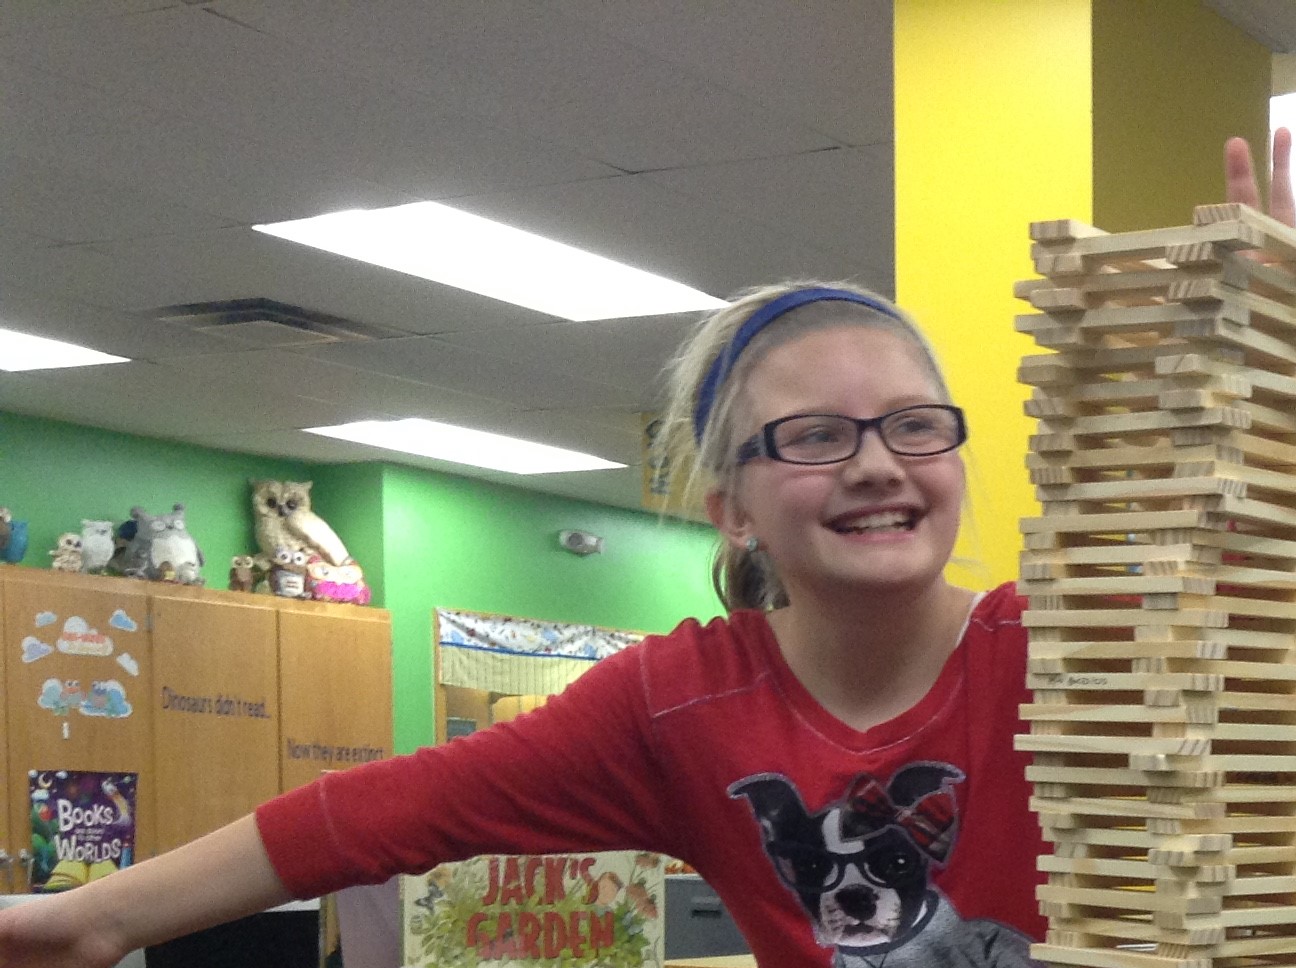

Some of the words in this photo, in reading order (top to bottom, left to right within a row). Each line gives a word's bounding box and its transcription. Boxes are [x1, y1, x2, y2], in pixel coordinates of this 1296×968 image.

[162, 685, 212, 714] Dinosaurs
[287, 738, 311, 759] Now
[312, 741, 333, 764] they
[336, 746, 350, 762] are
[483, 856, 599, 906] JACK'S
[466, 911, 616, 961] GARDEN
